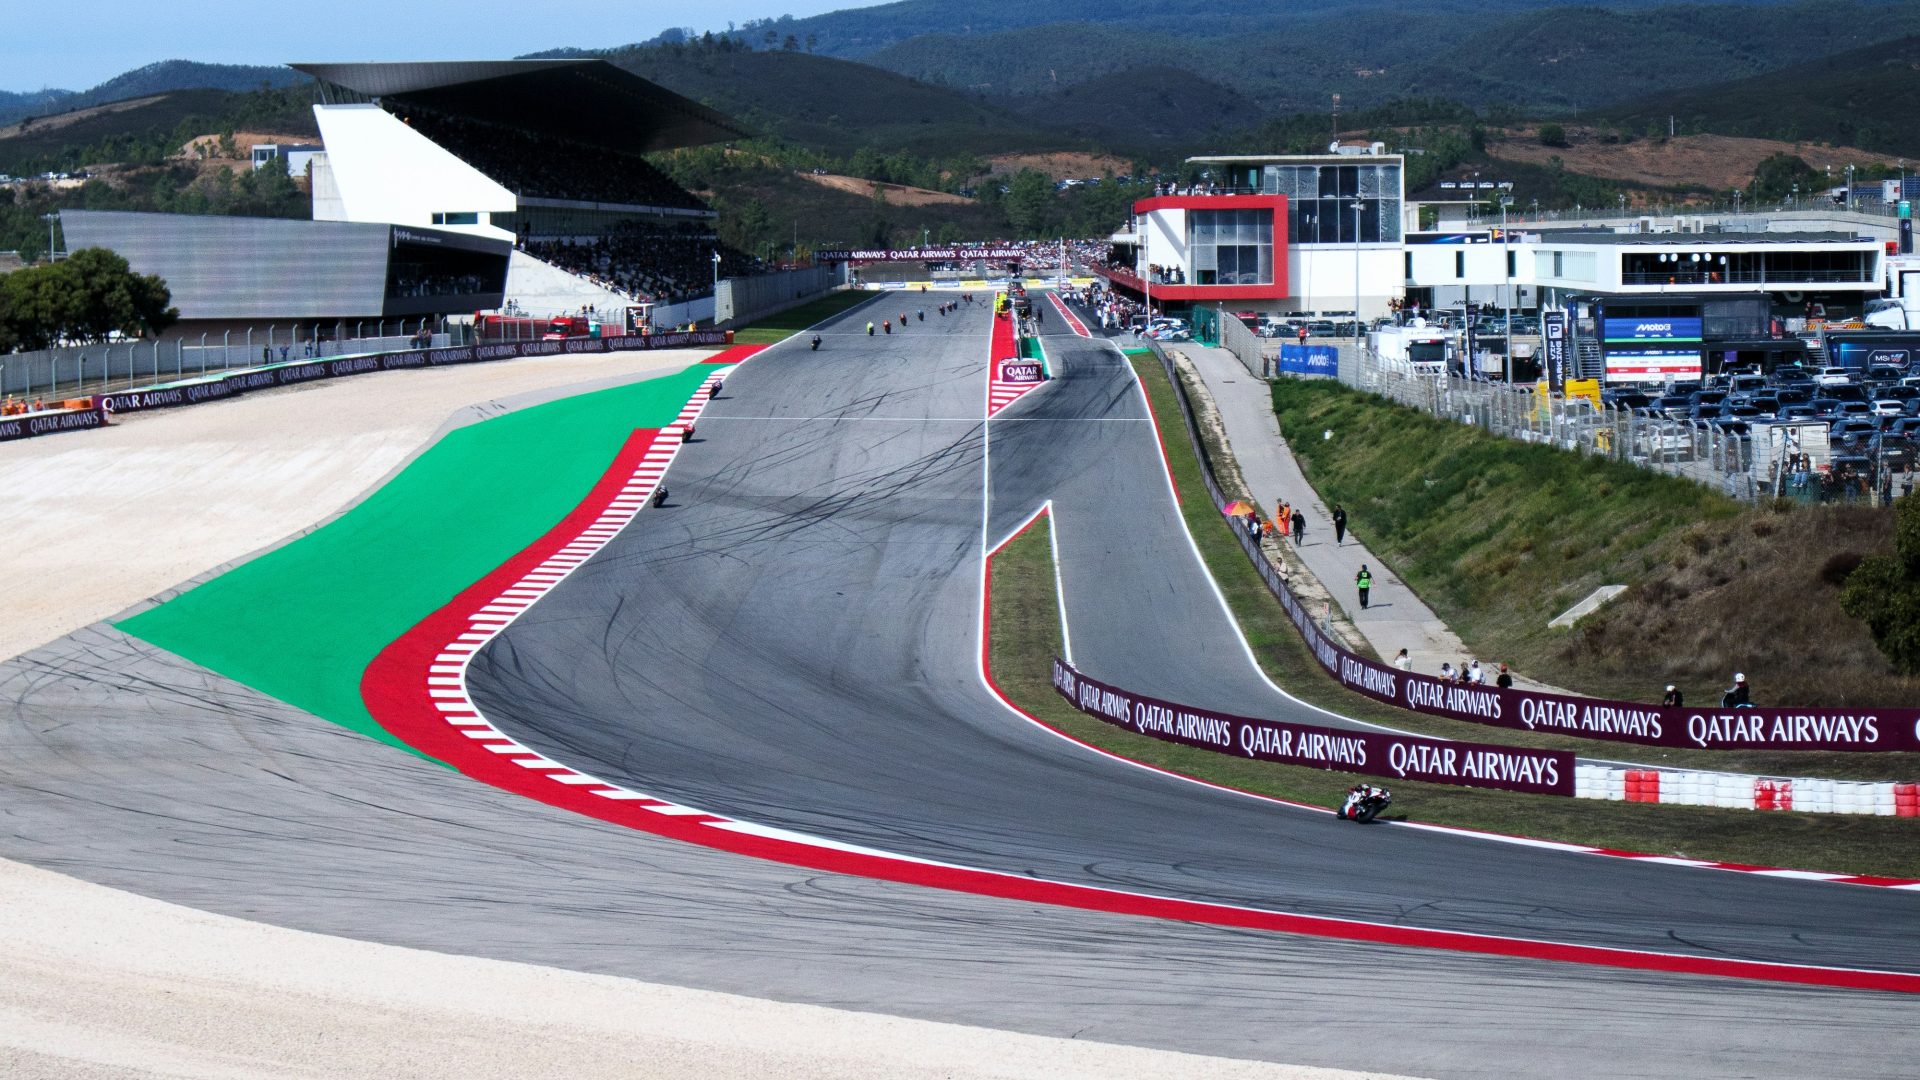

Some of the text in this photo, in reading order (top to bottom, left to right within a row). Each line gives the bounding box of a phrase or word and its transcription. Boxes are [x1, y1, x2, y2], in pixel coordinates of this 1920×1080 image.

[821, 251, 849, 259] QATAR
[890, 250, 956, 258] QATAR AIRWAYS
[960, 250, 1026, 258] QATAR AIRWAYS
[1550, 326, 1560, 336] P
[566, 340, 584, 354] QATAR
[666, 334, 688, 345] AIRWAYS
[430, 349, 472, 364] QATAR AIRWAYS
[476, 344, 517, 359] QATAR AIRWAYS
[522, 342, 560, 355] QATAR AIRWAYS
[332, 357, 378, 374] QATAR AIRWAYS
[383, 353, 425, 369] QATAR AIRWAYS
[247, 371, 274, 387] AIRWAYS
[279, 364, 326, 384] QATAR AIRWAYS
[1006, 366, 1038, 376] QATAR
[188, 384, 208, 400] QATAR
[102, 390, 182, 412] QATAR AIRWAYS
[30, 411, 99, 434] QATAR AIRWAYS
[1341, 656, 1396, 698] QATAR AIRWAYS
[1080, 682, 1130, 724] QATAR AIRWAYS
[1407, 679, 1501, 719] QATAR AIRWAYS
[1136, 702, 1231, 747] QATAR AIRWAYS
[1520, 698, 1662, 739] QATAR AIRWAYS
[1688, 714, 1766, 748] QATAR
[1770, 716, 1879, 743] AIRWAYS
[1240, 724, 1366, 766] QATAR AIRWAYS
[1390, 743, 1559, 786] QATAR AIRWAYS
